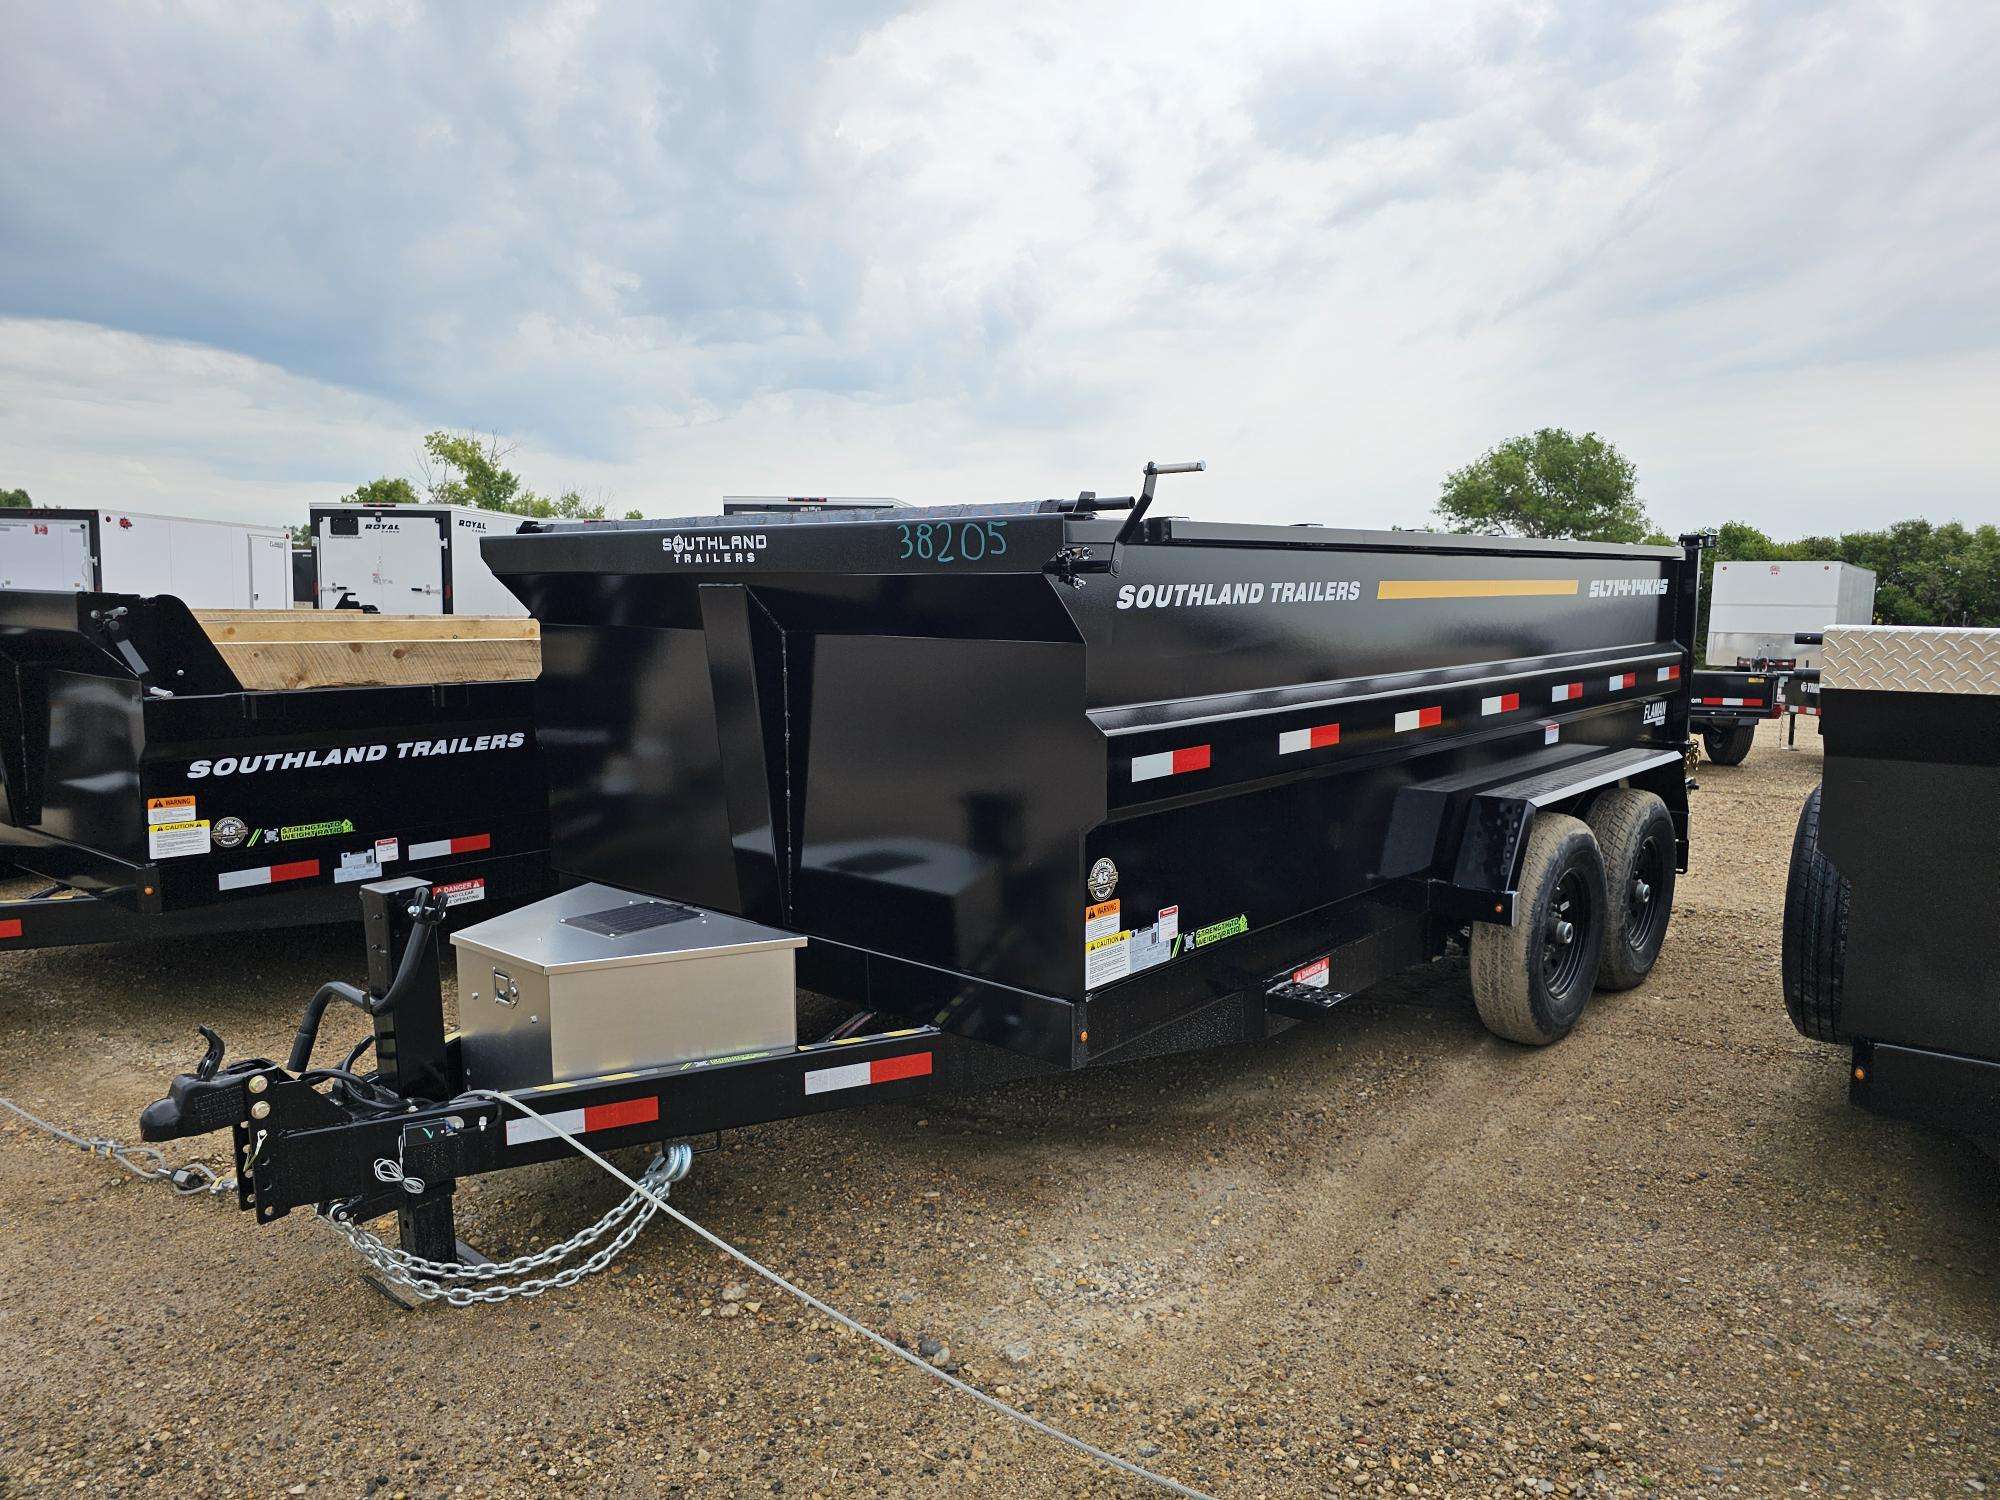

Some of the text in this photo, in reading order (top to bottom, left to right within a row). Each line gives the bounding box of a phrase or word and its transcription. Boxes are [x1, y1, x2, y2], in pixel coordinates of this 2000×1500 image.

[458, 519, 487, 530] ROYAL
[662, 534, 767, 552] SOUTHLAND
[896, 520, 1008, 563] 38205
[674, 552, 756, 563] TRAILERS
[1116, 581, 1361, 610] SOUTHLAND TRAILERS
[1643, 700, 1667, 720] FLAMAN
[187, 732, 525, 778] SOUTHLAND TRAILERS
[165, 798, 191, 806] WARNING
[165, 822, 195, 830] CAUTION
[222, 827, 236, 836] 45
[282, 827, 343, 840] WEIGHT RATIO
[444, 882, 472, 893] DANGER
[1097, 902, 1117, 915] WARNING
[1196, 921, 1230, 938] STRENGTH
[1196, 924, 1240, 945] WEIGHT RATIO
[1096, 937, 1119, 949] CAUTION
